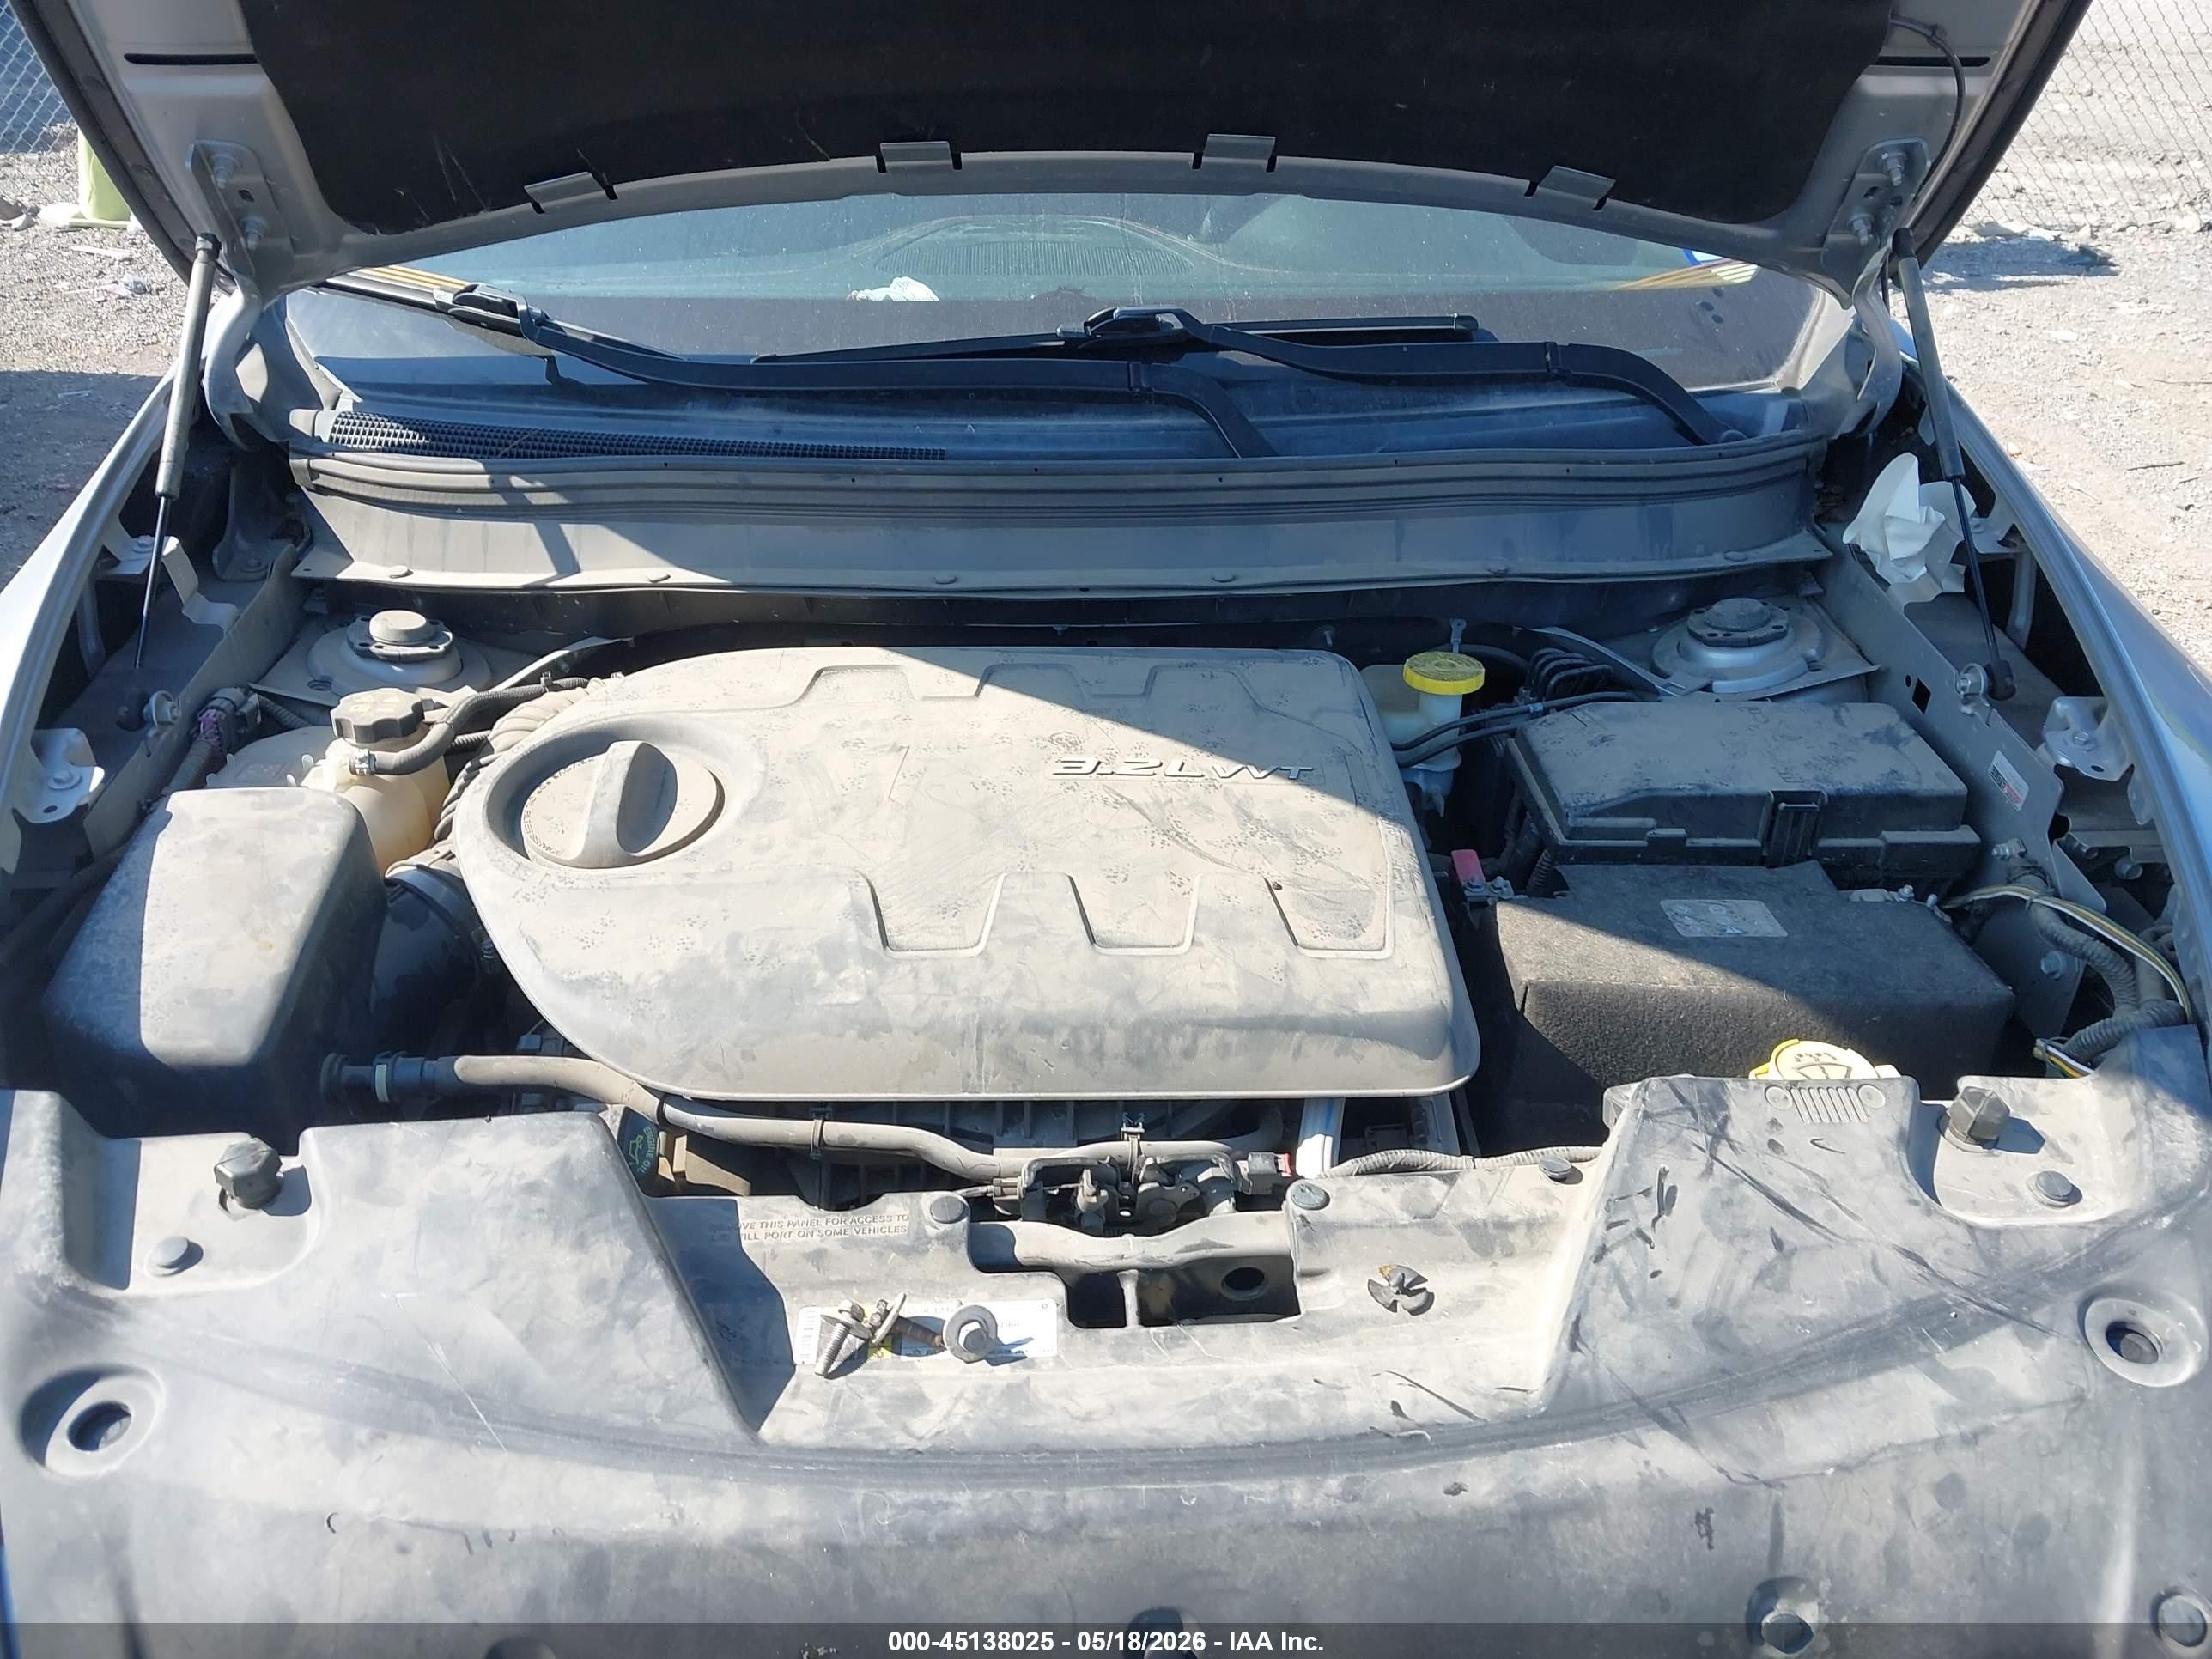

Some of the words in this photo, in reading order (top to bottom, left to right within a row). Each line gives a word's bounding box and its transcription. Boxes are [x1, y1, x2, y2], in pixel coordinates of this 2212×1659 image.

[1052, 756, 1205, 778] 3.2L
[643, 1126, 656, 1158] ENGINE
[639, 1159, 651, 1174] OIL
[760, 1220, 784, 1229] THIS
[787, 1218, 823, 1228] PANEL
[825, 1217, 848, 1225] FOR
[850, 1215, 893, 1224] ACCESS
[896, 1213, 910, 1222] TO
[764, 1231, 793, 1240] PORT
[797, 1229, 814, 1238] ON
[817, 1228, 850, 1237] SOME
[853, 1225, 908, 1236] VEHICLES
